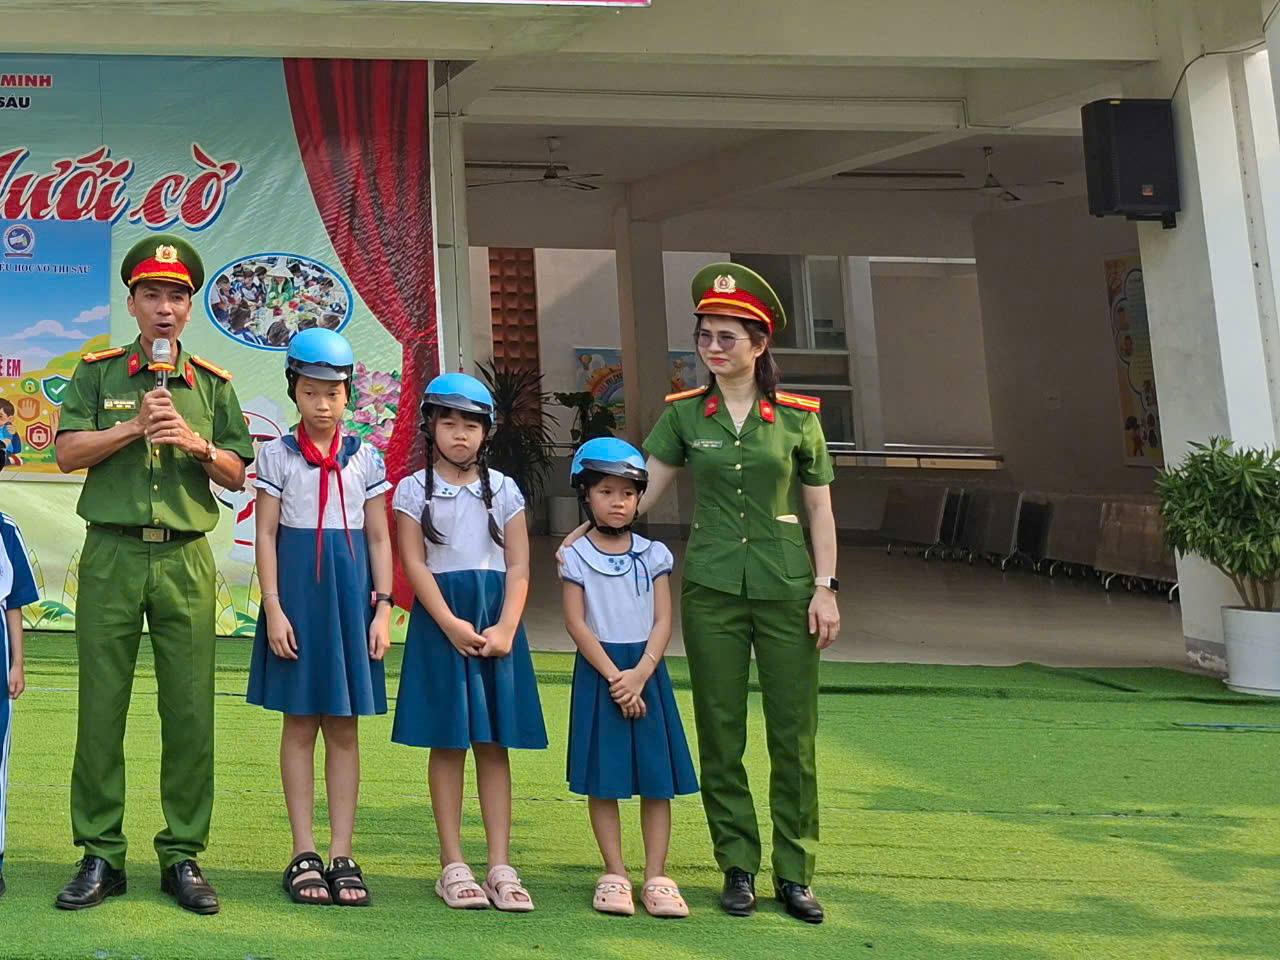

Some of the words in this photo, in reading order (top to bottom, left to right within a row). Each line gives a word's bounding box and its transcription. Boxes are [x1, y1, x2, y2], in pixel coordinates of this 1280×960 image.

[0, 74, 52, 87] MINH
[128, 142, 243, 232] cờ
[6, 359, 21, 377] EM
